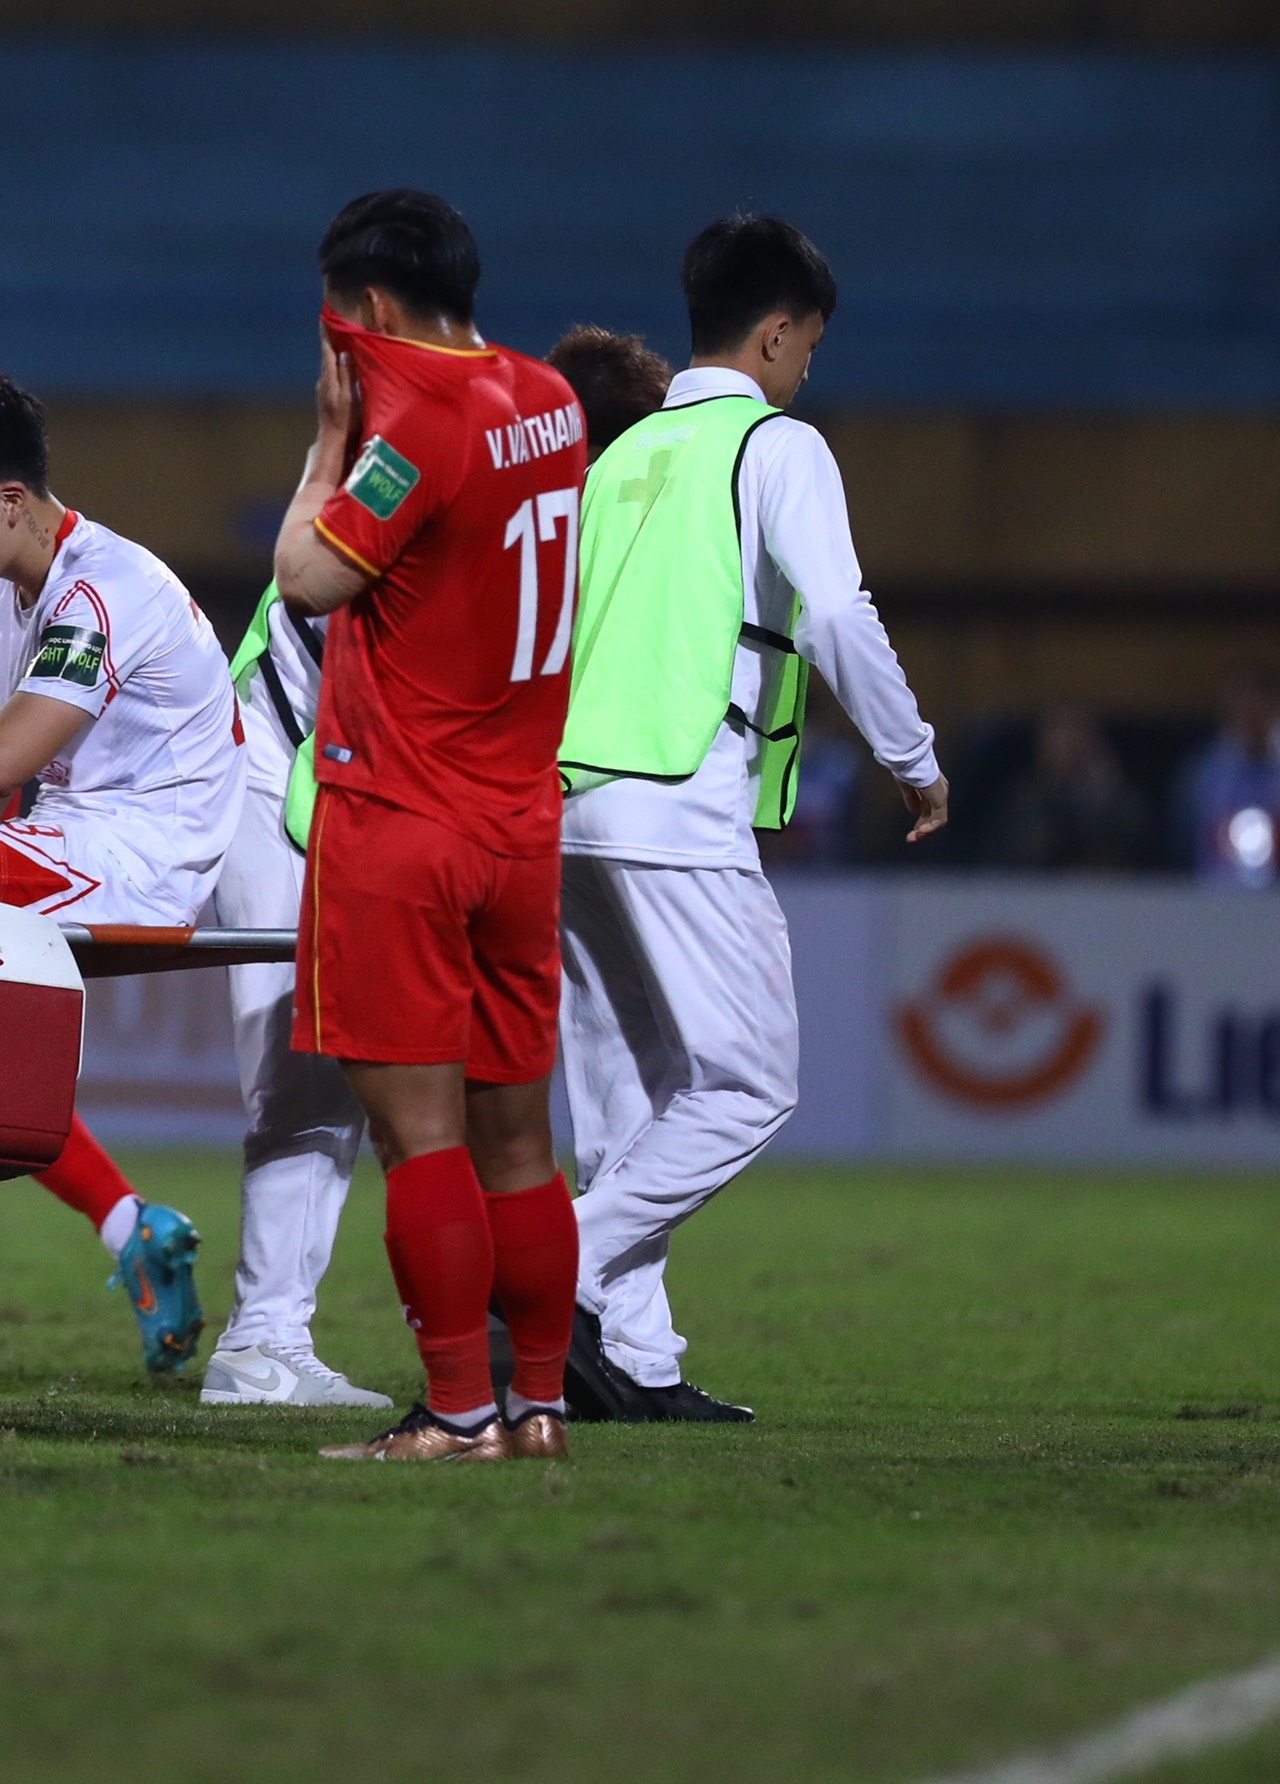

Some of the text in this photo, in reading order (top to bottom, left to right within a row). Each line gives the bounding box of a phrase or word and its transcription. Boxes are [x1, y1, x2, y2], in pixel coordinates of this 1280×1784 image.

[503, 486, 579, 683] 17
[41, 646, 100, 671] GHT WOLF
